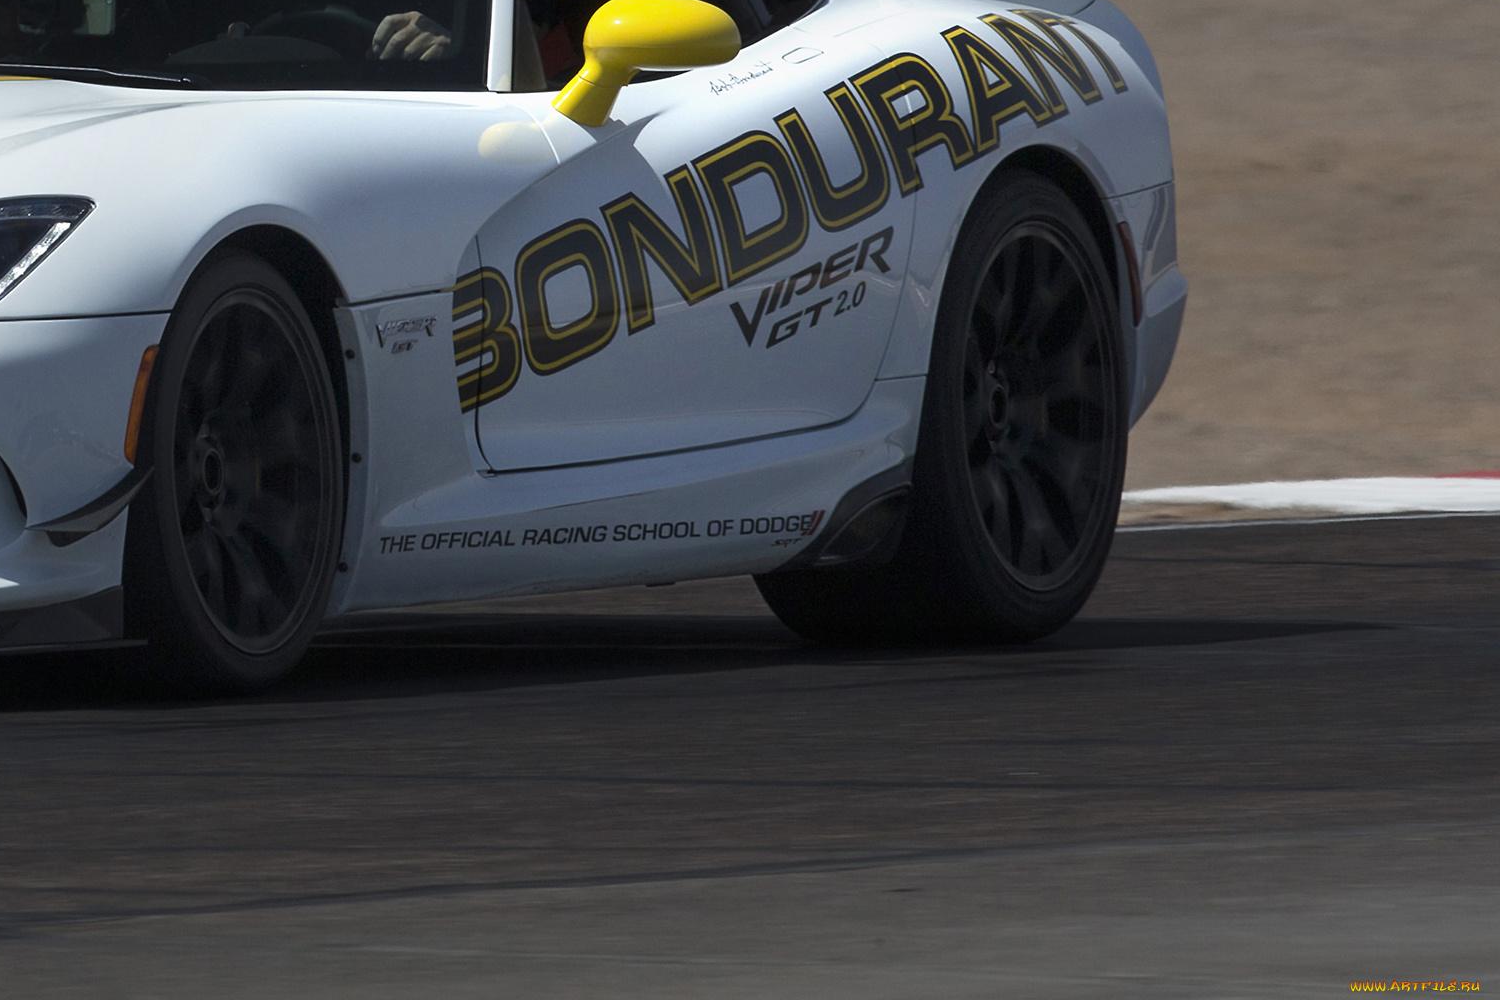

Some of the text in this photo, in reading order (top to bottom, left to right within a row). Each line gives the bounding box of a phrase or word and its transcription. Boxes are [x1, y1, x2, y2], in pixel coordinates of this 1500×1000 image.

[452, 9, 1129, 413] BONDURANT
[729, 225, 894, 348] VIPER
[766, 281, 867, 349] GT 2.0
[376, 316, 438, 349] VIPER
[380, 514, 813, 554] THE OFFICIAL RACING SCHOOL OF DODGE
